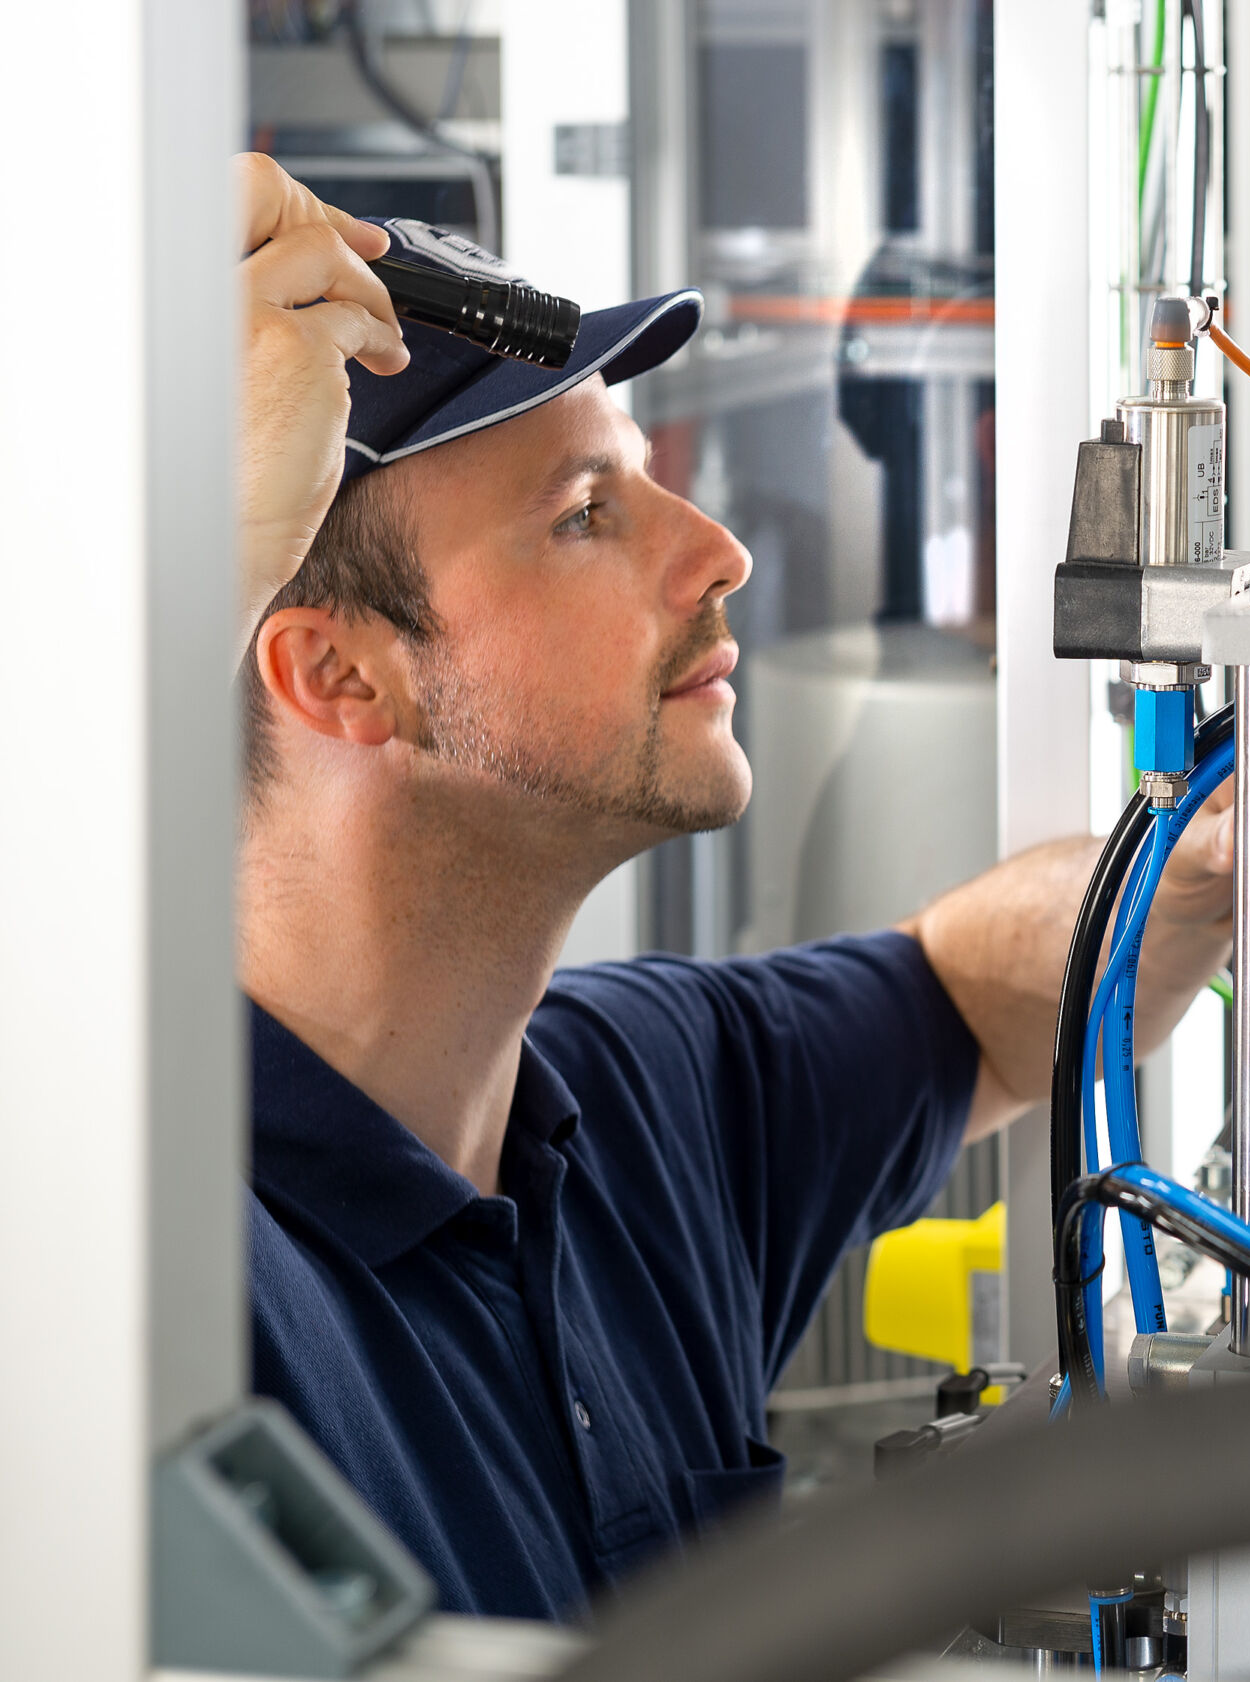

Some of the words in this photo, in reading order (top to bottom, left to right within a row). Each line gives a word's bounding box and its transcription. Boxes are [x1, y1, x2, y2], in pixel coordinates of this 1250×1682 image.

[1197, 463, 1205, 477] UB
[1174, 791, 1206, 828] Pneumatic
[1121, 1037, 1132, 1057] 0,25
[1140, 1220, 1153, 1256] STO
